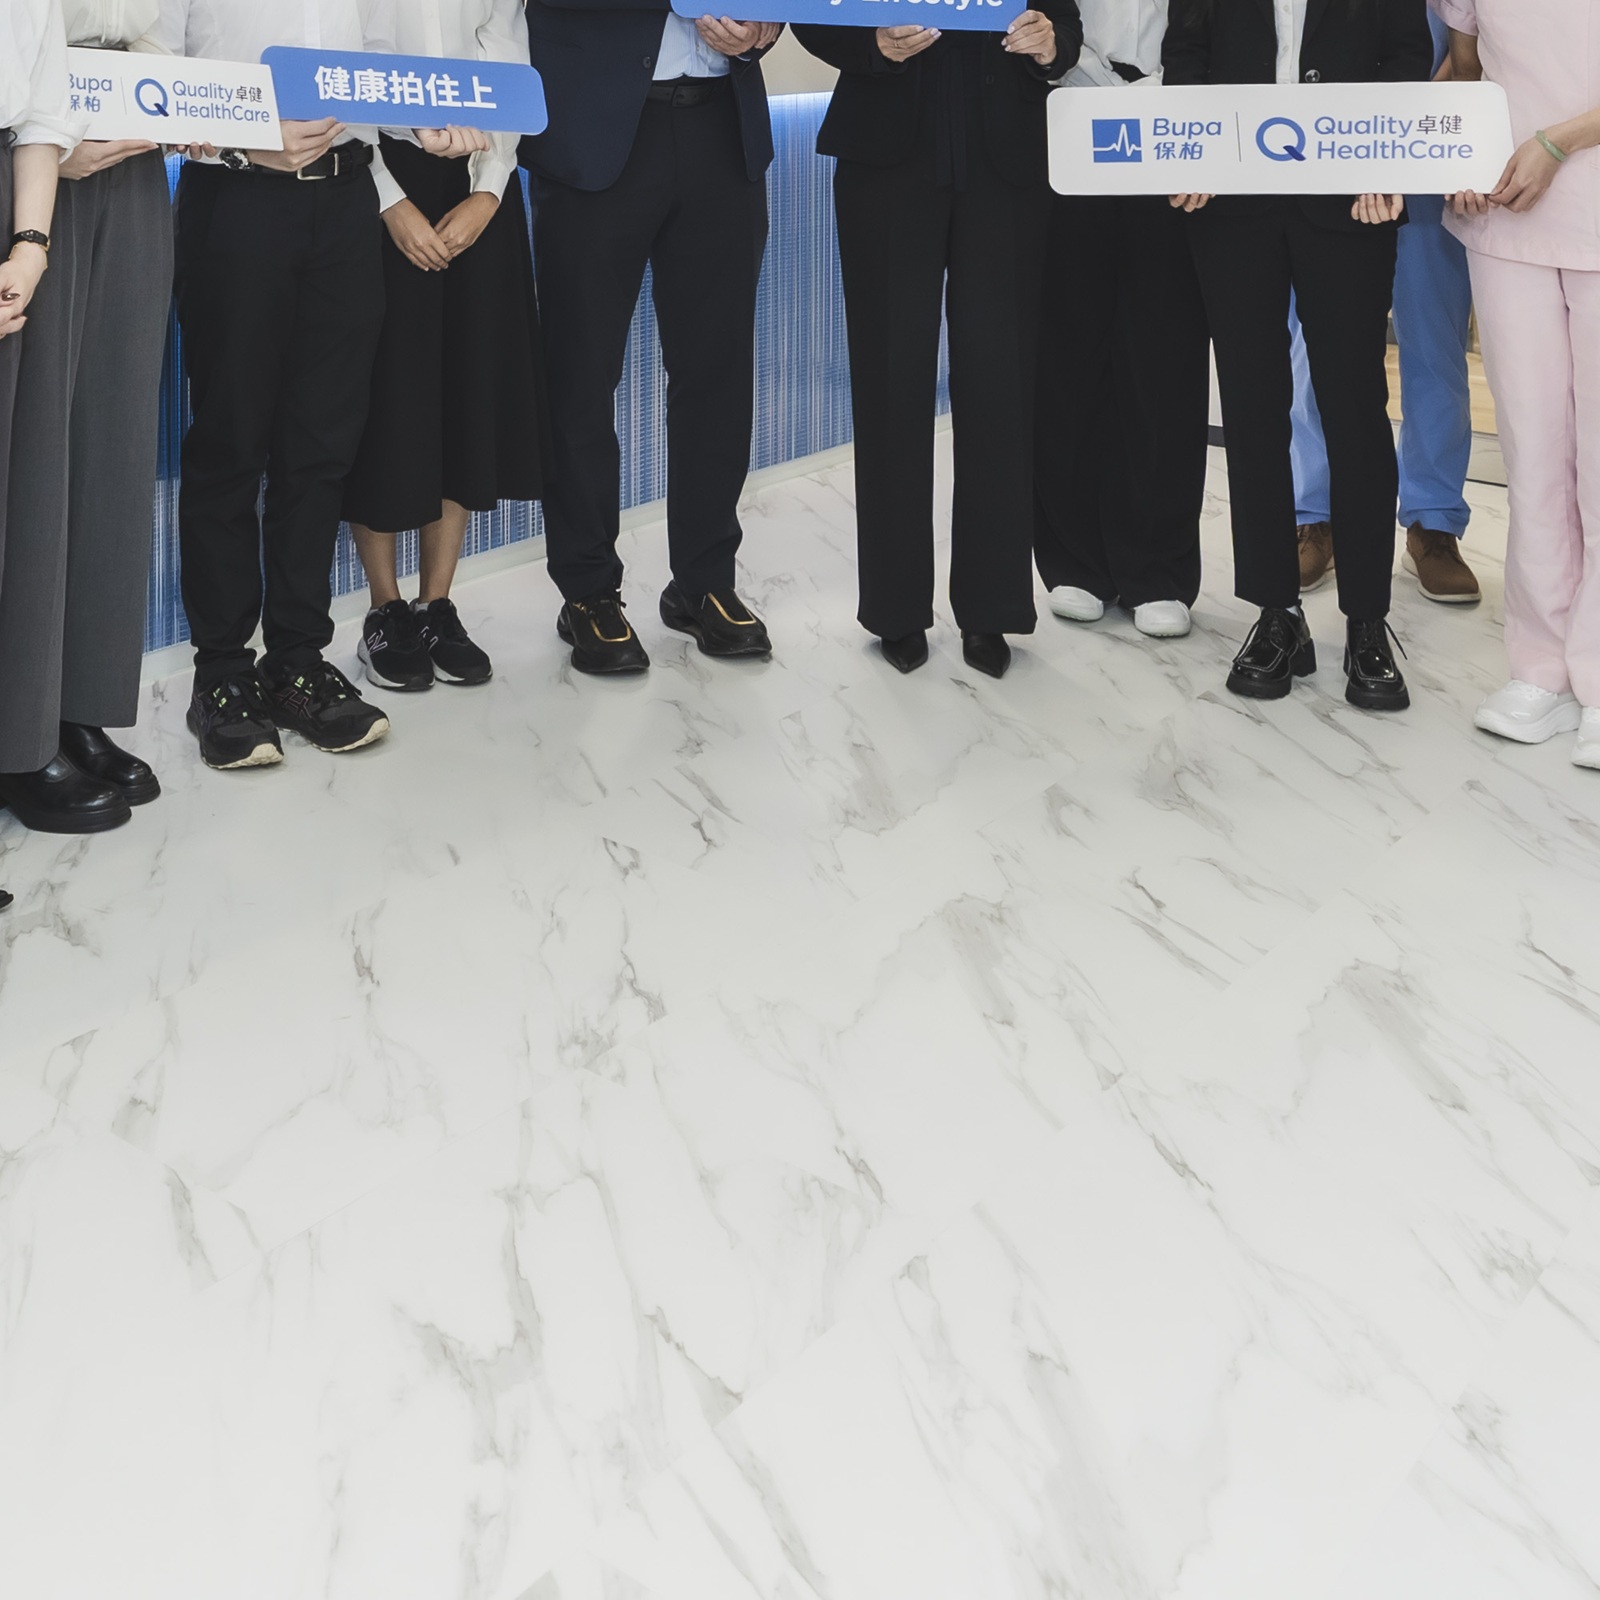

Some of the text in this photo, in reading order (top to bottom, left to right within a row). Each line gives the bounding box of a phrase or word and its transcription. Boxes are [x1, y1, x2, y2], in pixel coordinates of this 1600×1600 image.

[172, 80, 263, 104] Quality 卓健
[314, 65, 498, 110] 健康拍住上
[175, 100, 271, 123] HealthCare
[1152, 117, 1223, 139] Bupa
[1313, 114, 1464, 139] Quality 卓健
[1152, 141, 1204, 161] 保柏
[1316, 139, 1474, 161] HealthCare
